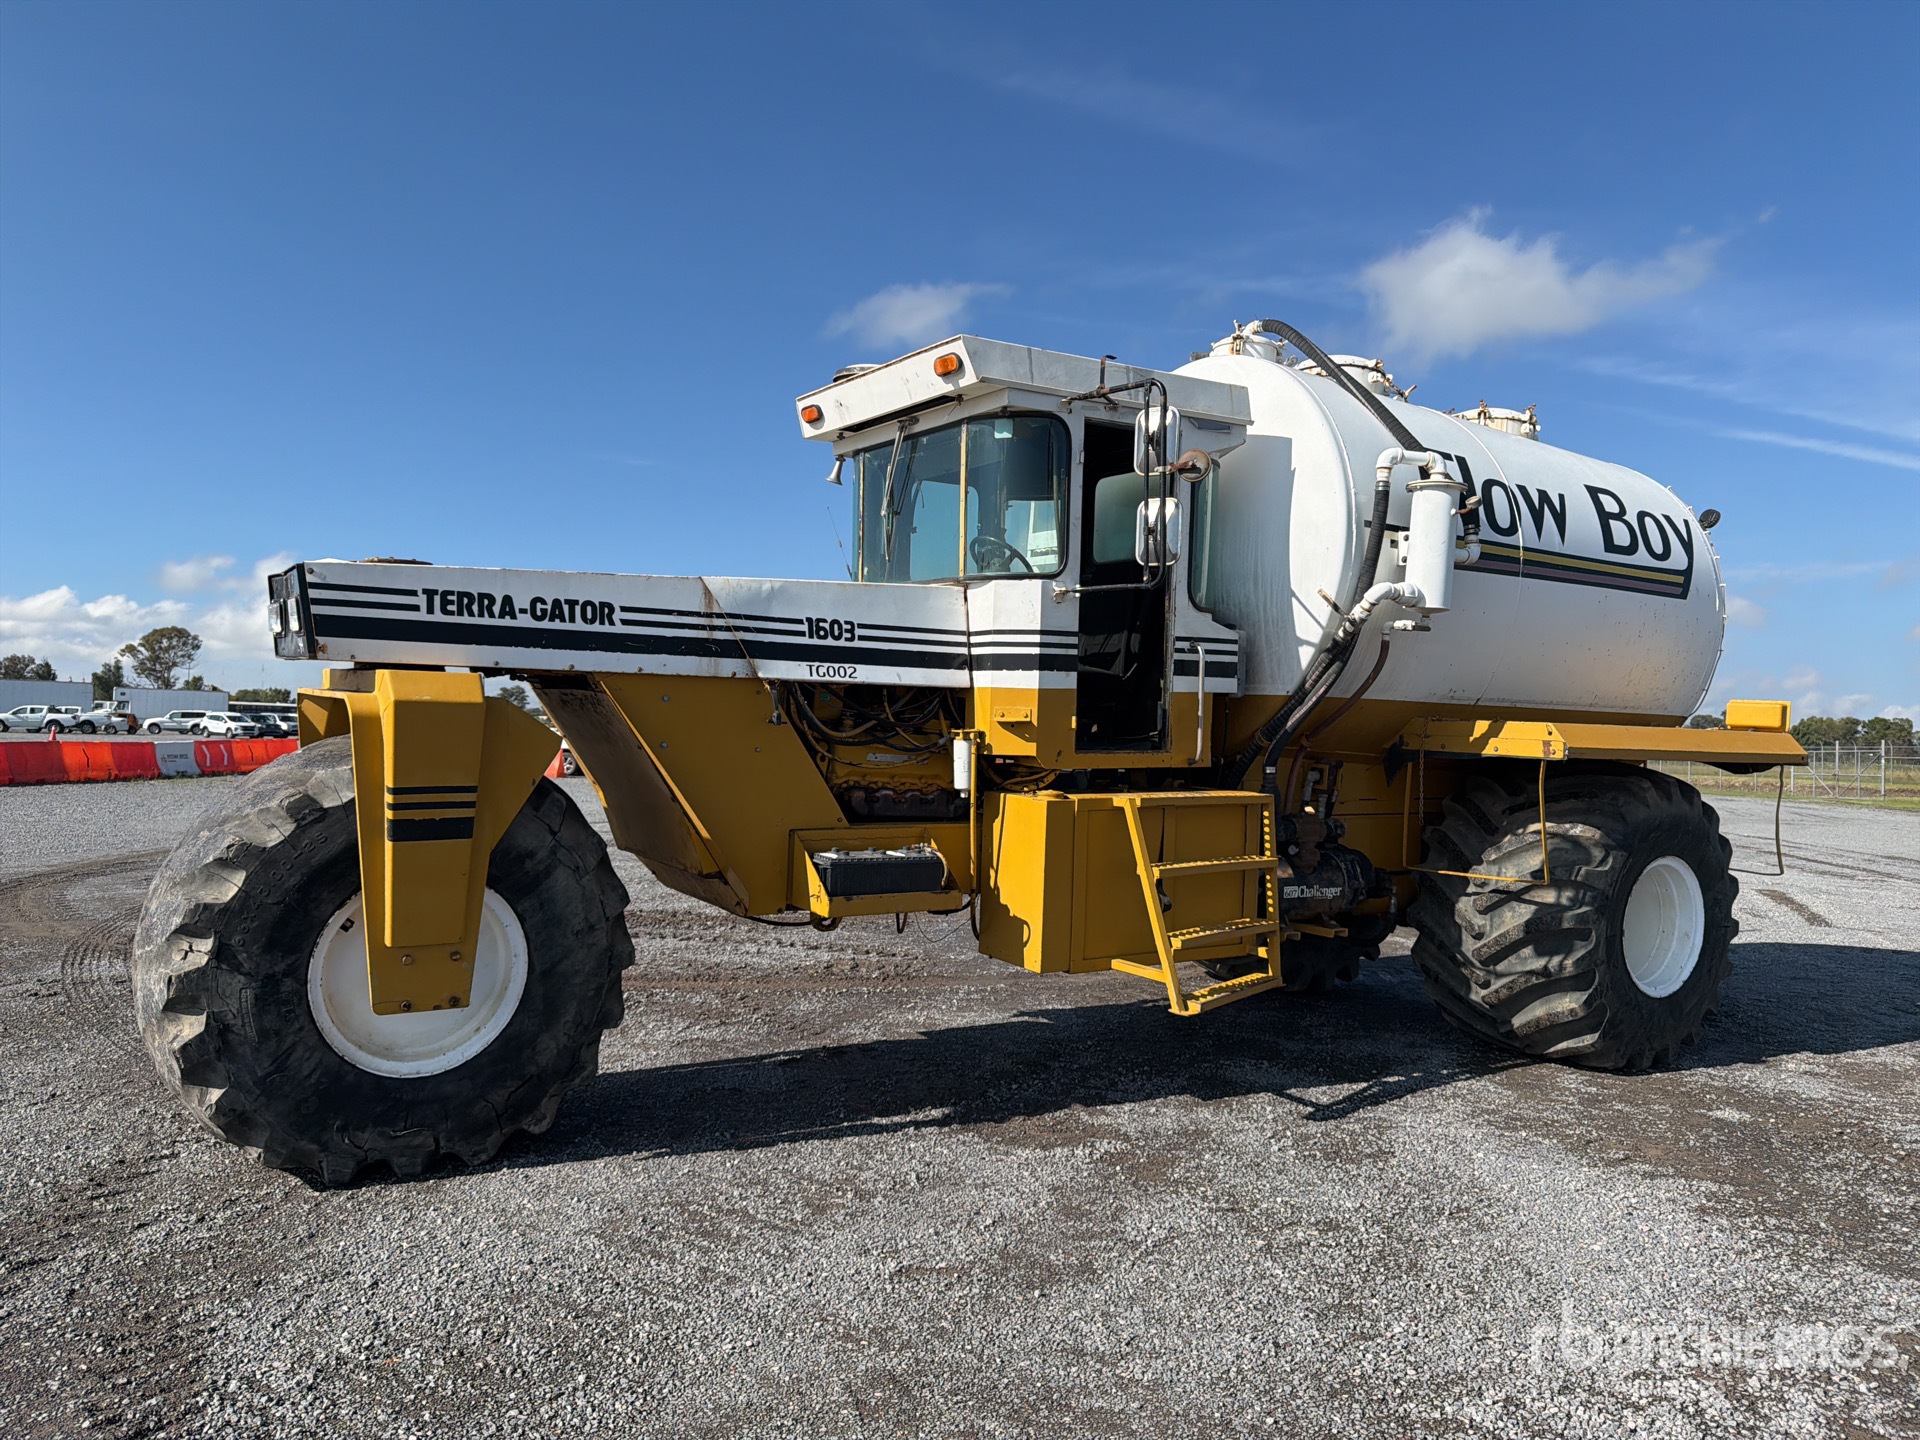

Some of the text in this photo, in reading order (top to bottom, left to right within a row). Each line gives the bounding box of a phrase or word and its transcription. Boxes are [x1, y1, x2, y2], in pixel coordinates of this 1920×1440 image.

[1583, 484, 1694, 582] Boy
[422, 588, 616, 626] TERRA-GATOR
[805, 616, 856, 643] 1603
[806, 664, 858, 679] TG002
[1298, 885, 1342, 899] Challenger
